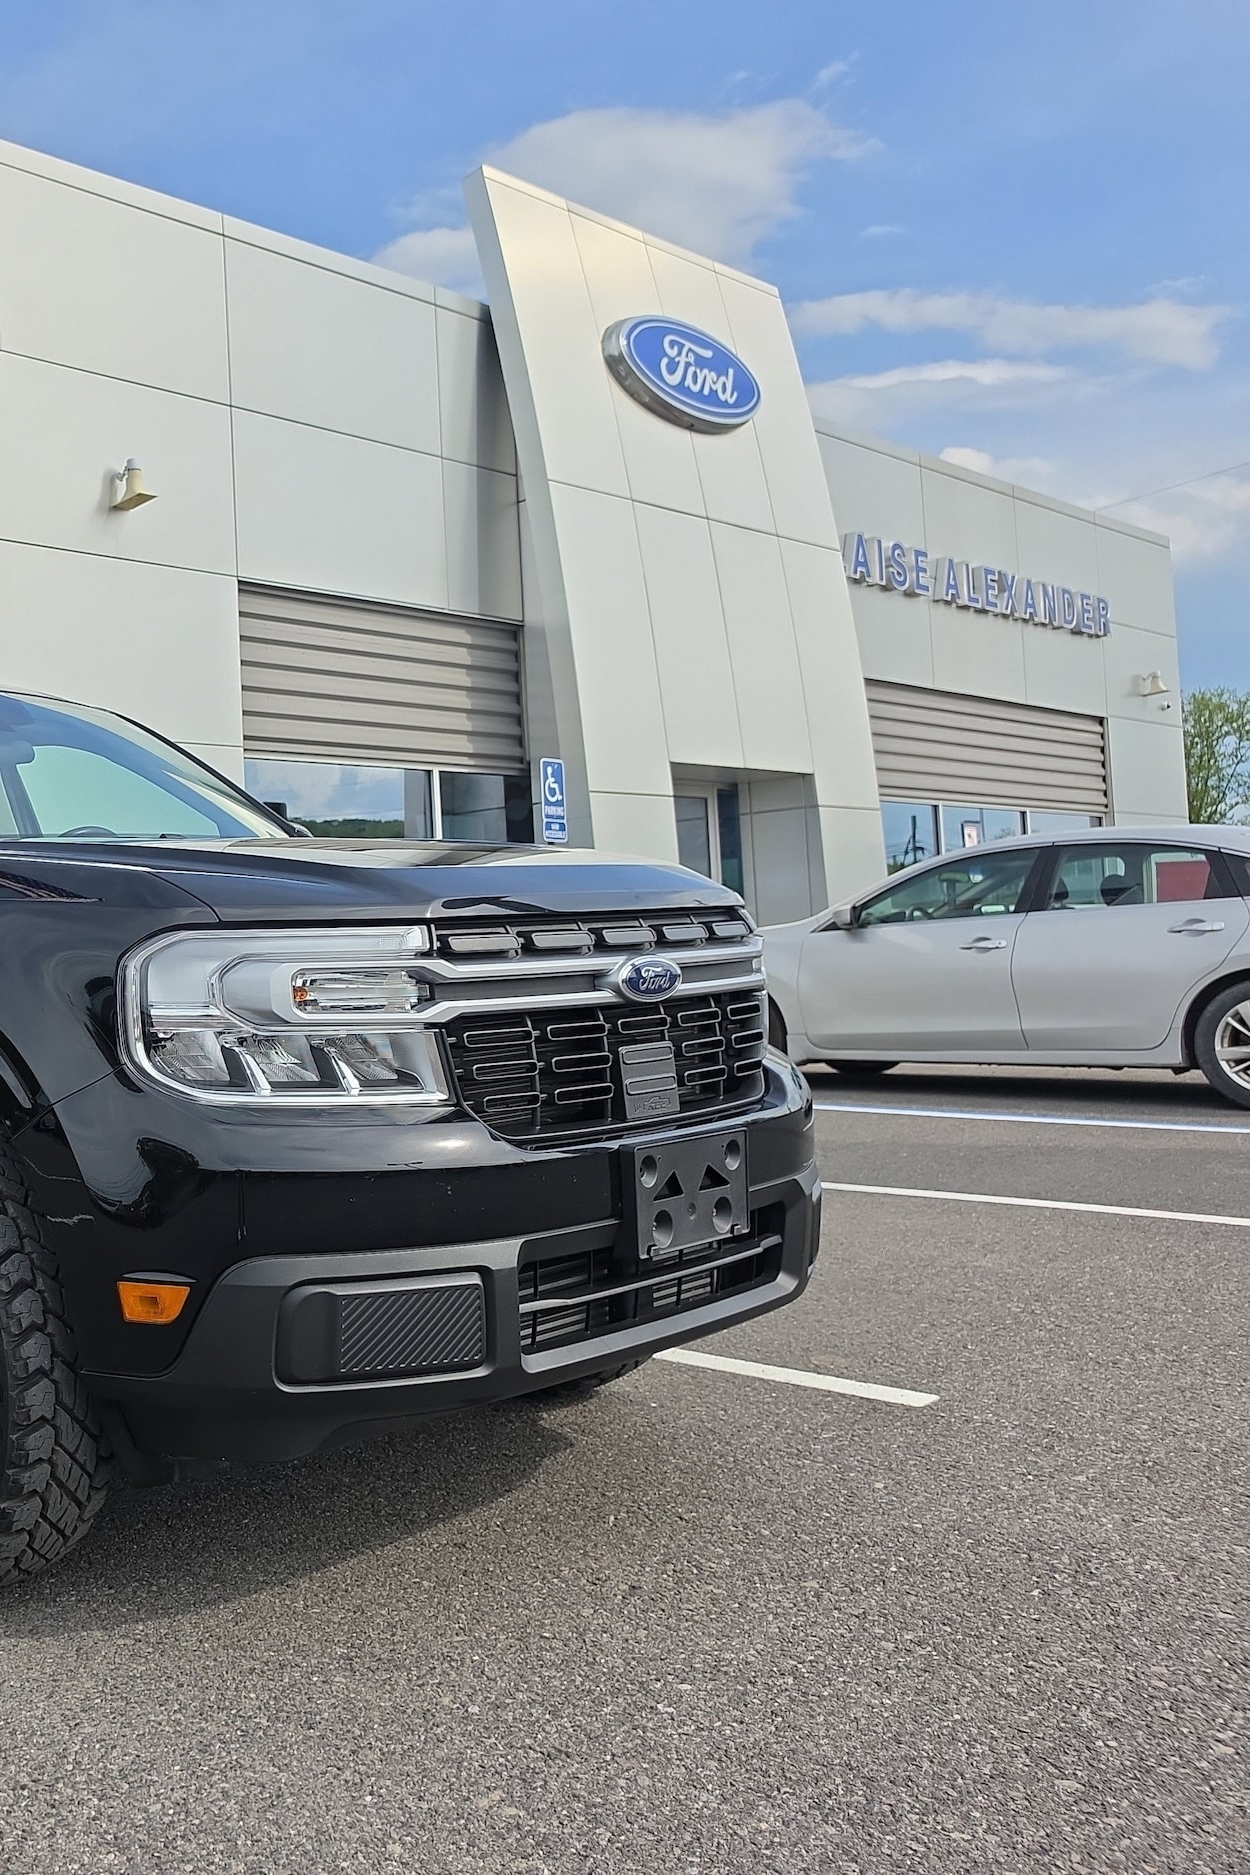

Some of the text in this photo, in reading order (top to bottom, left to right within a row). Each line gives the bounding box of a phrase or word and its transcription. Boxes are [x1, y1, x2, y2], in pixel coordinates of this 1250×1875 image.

[660, 334, 738, 405] Ford
[844, 531, 1112, 637] AISE ALEXANDER
[639, 966, 671, 991] Ford
